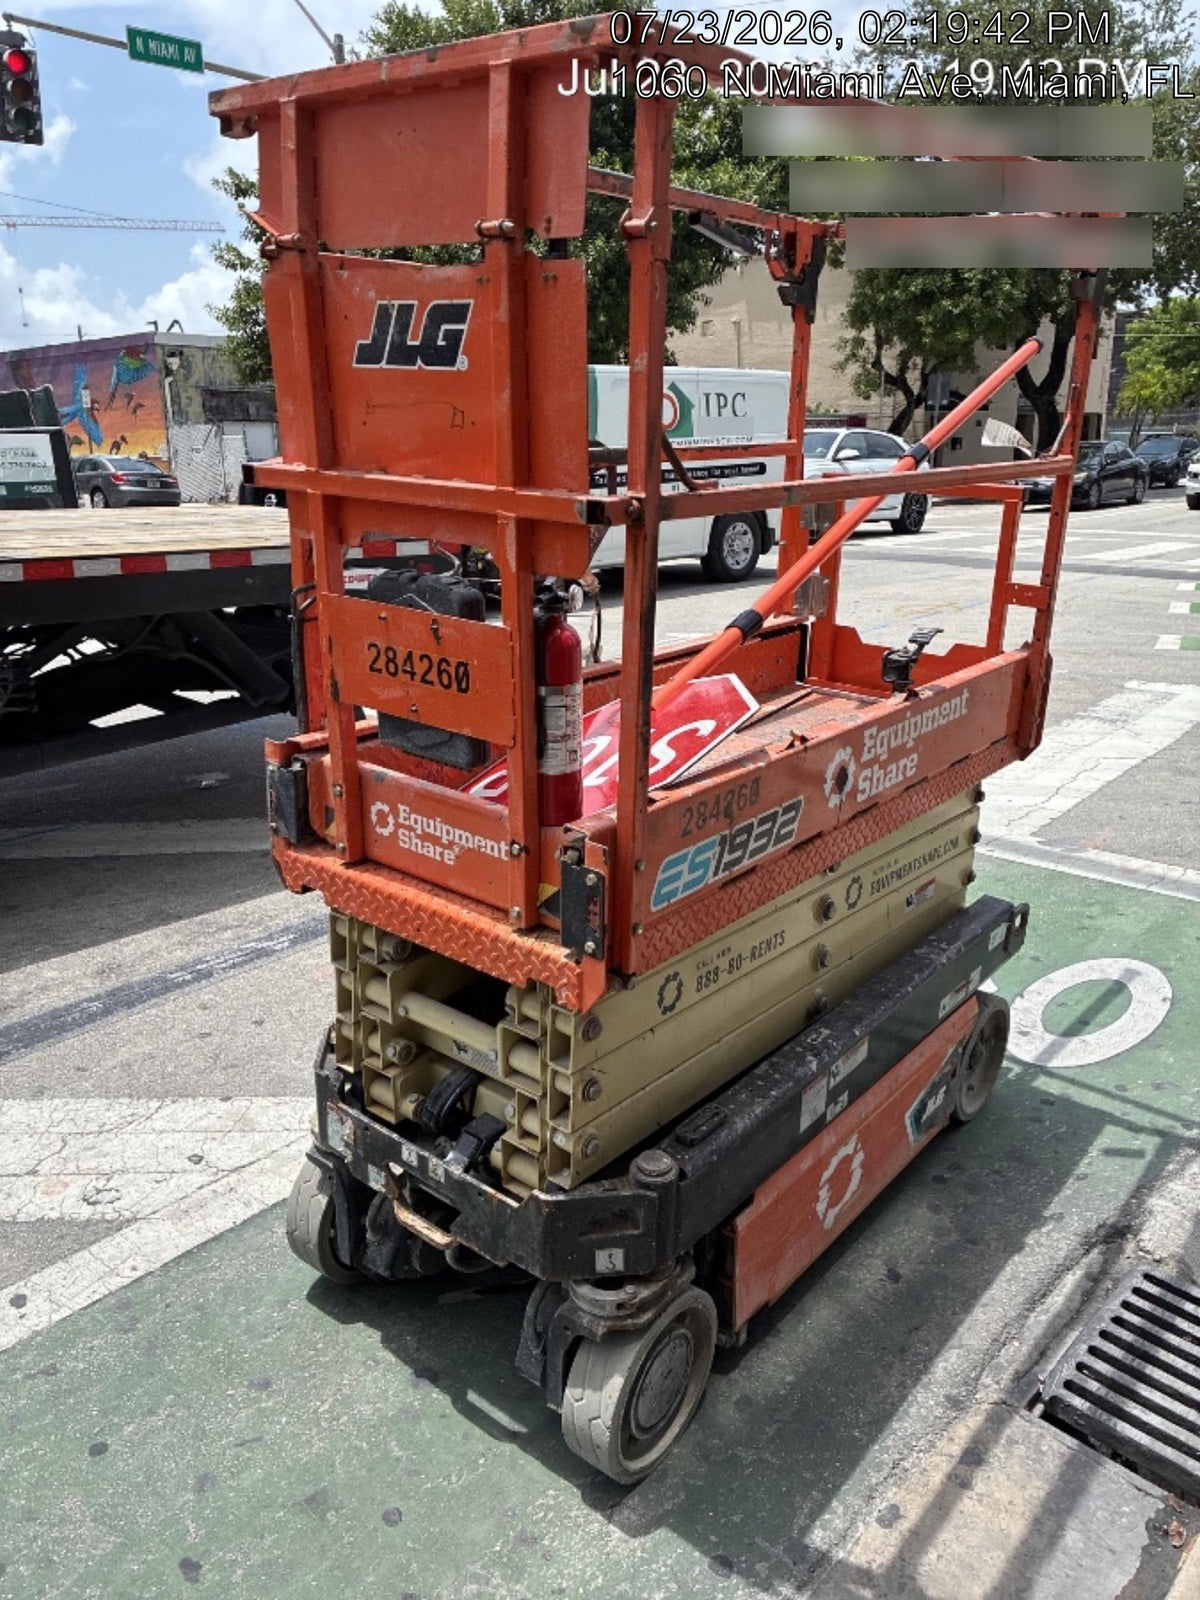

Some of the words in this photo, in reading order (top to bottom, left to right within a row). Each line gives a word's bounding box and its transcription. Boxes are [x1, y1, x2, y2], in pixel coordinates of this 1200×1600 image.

[136, 36, 145, 54] N
[148, 38, 180, 61] MIAMI
[184, 46, 197, 63] AV
[352, 299, 474, 370] JLG
[703, 391, 748, 417] IPC
[367, 642, 471, 695] 284260
[859, 687, 970, 763] Equipment
[856, 752, 919, 803] Share
[397, 804, 510, 861] Equipment
[397, 829, 456, 866] Share
[650, 795, 805, 912] ES1932
[695, 929, 786, 993] 888-80-RENTS
